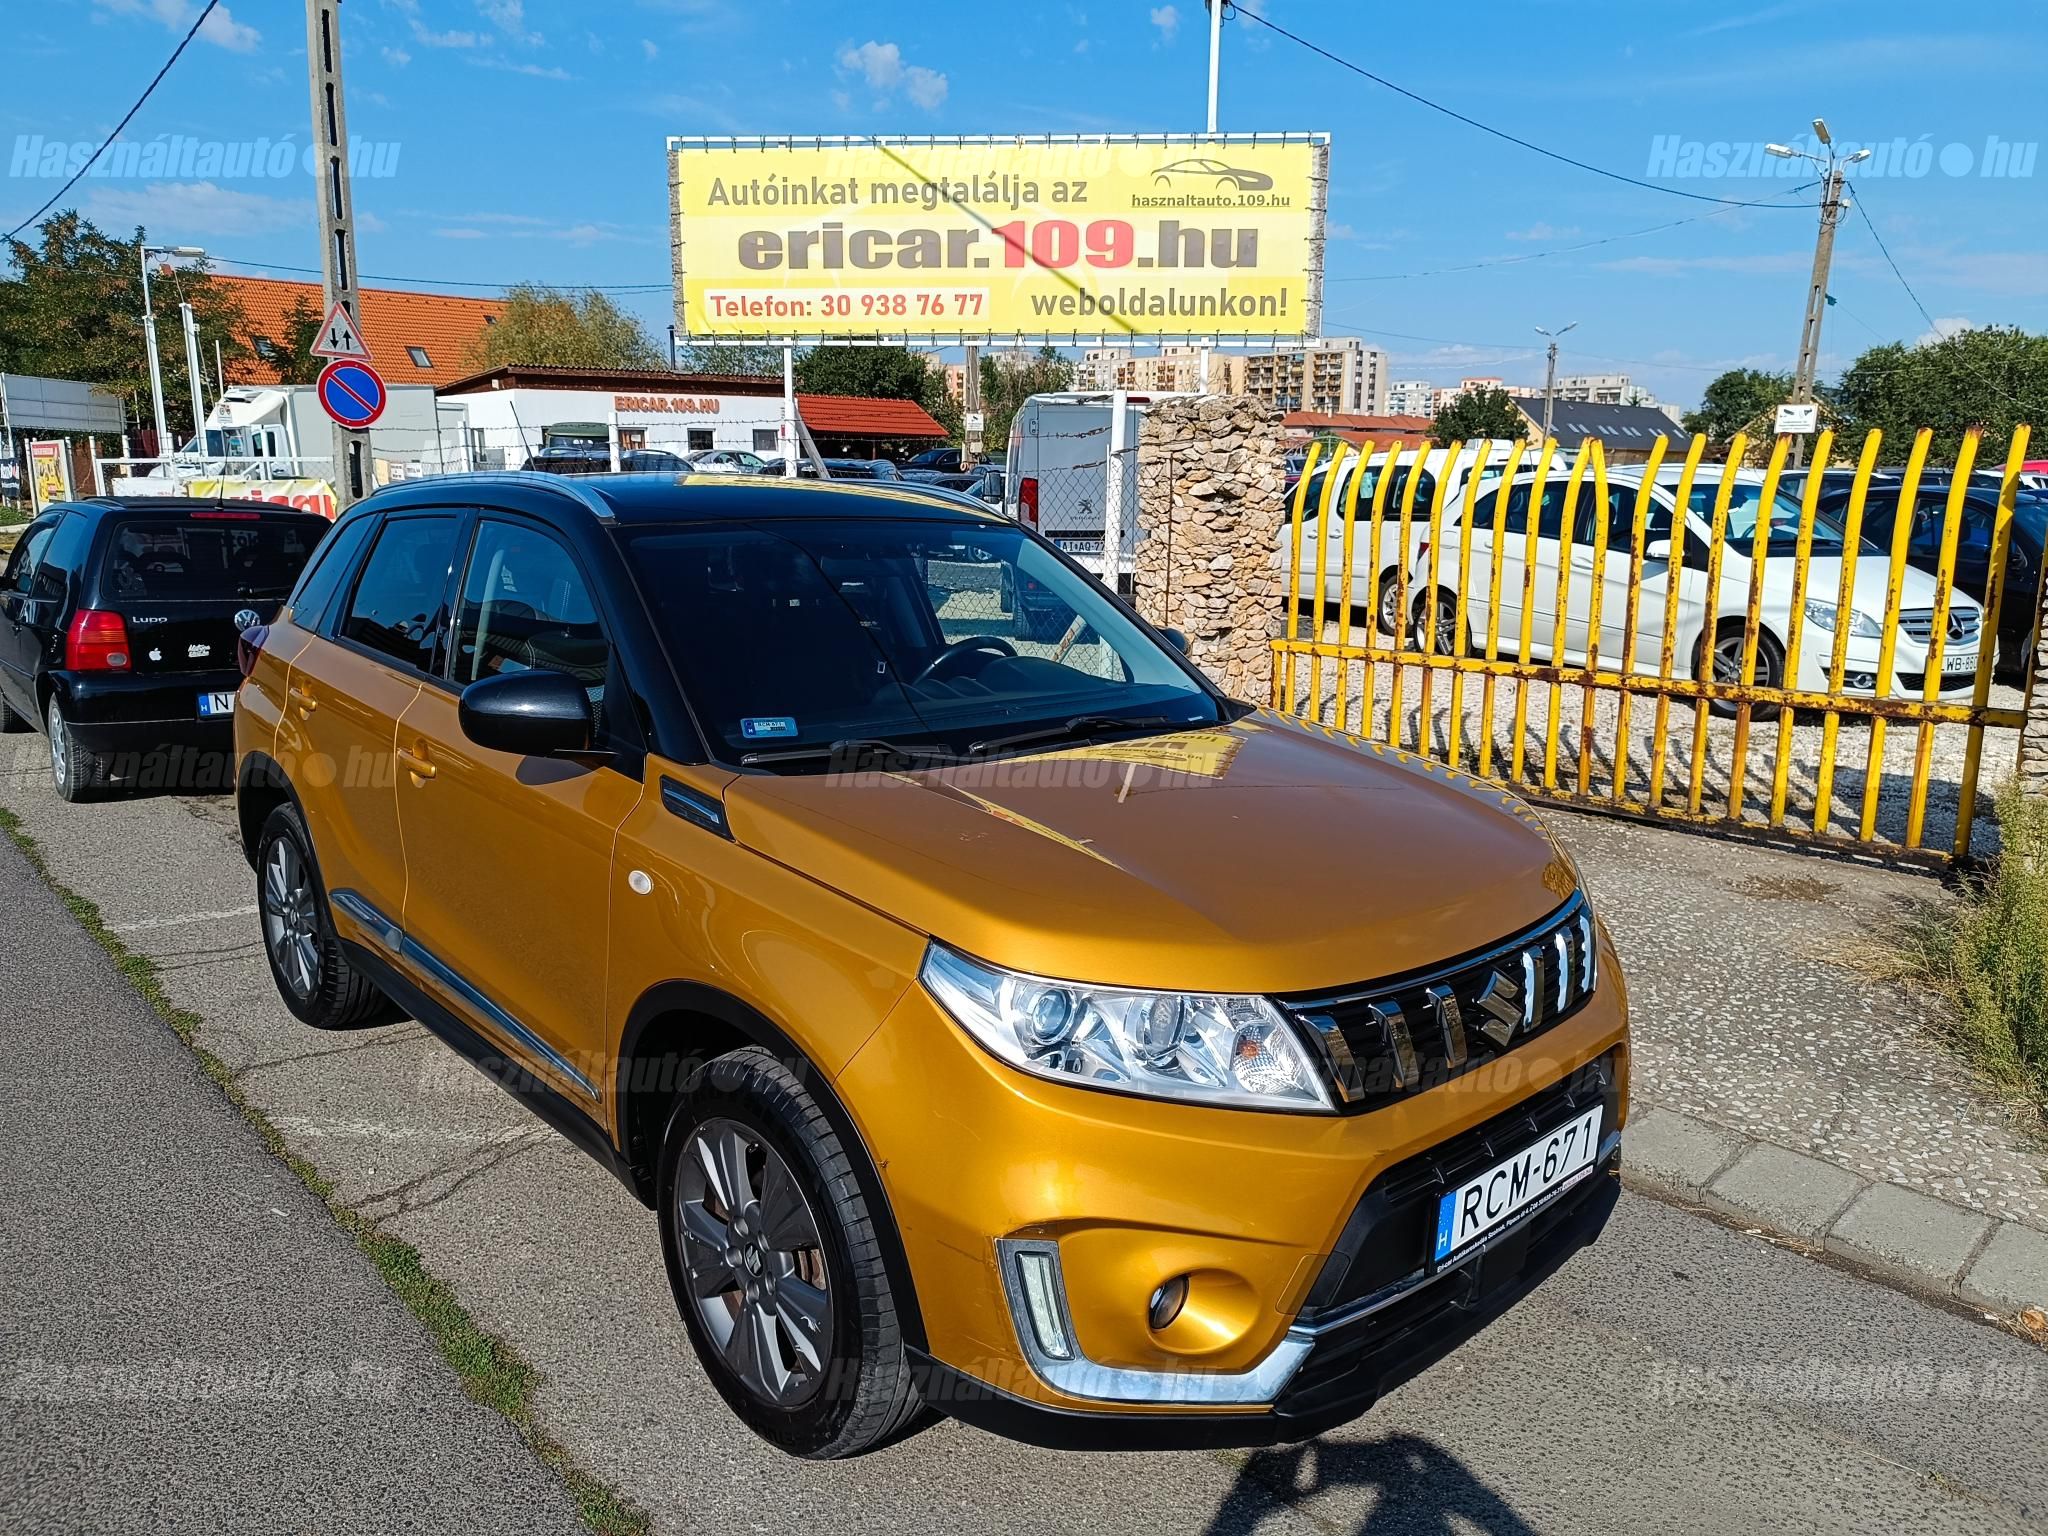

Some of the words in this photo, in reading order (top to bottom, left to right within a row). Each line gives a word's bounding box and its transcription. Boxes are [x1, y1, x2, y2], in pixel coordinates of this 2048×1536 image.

[708, 173, 858, 206] Autóinkat
[871, 170, 1039, 211] megtalálja
[1051, 181, 1088, 203] az
[1131, 193, 1291, 208] hasznaltauto.109.hu
[738, 219, 1258, 270] ericar.109.hu
[710, 294, 813, 317] Telefon:
[821, 294, 851, 316] 30
[861, 294, 907, 316] 938
[916, 294, 945, 316] 76
[954, 294, 983, 316] 77
[1031, 288, 1287, 317] weboldalunkon!
[614, 396, 720, 415] ERICAR.109.HU
[1459, 1115, 1593, 1239] RCM-671
[1437, 1229, 1448, 1250] H
